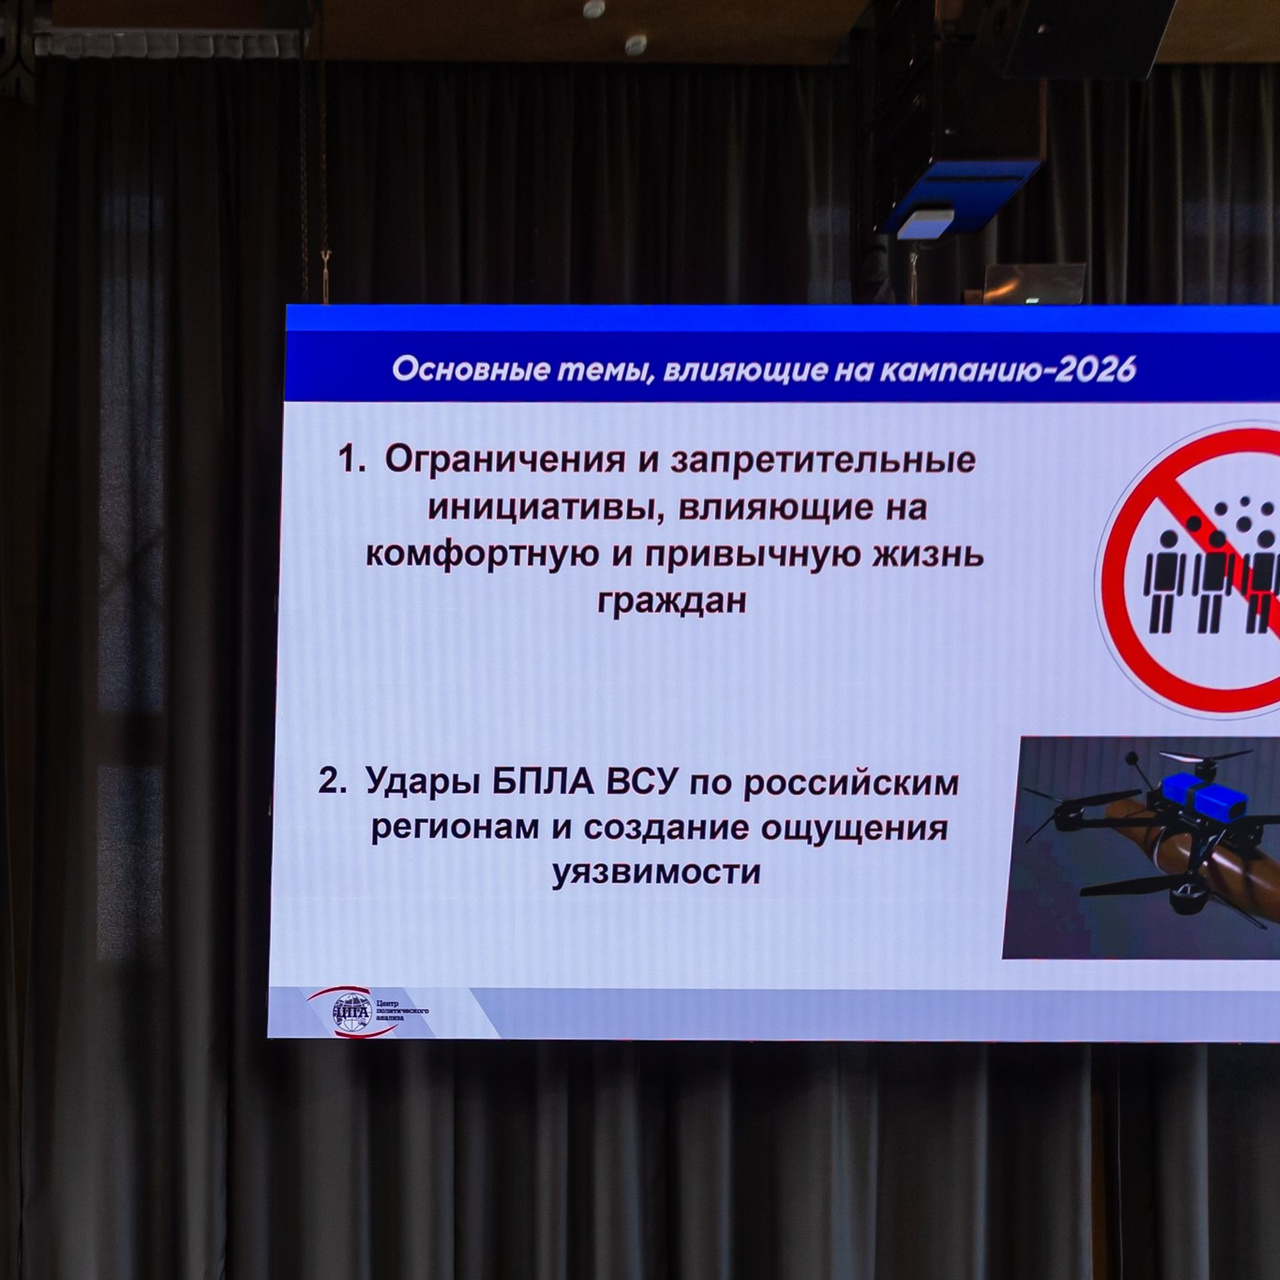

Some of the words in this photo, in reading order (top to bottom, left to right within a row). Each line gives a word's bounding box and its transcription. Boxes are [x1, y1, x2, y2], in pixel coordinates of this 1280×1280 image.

[392, 354, 552, 382] Основные
[557, 361, 655, 386] темы,
[663, 361, 829, 386] влияющие
[834, 362, 875, 382] на
[879, 354, 1137, 383] кампанию-2026
[339, 442, 366, 472] 1.
[385, 442, 626, 480] Ограничения
[638, 450, 659, 473] и
[670, 450, 976, 481] запретительные
[428, 497, 665, 526] инициативы,
[679, 498, 874, 526] влияющие
[886, 498, 927, 521] на
[366, 537, 600, 575] комфортную
[612, 545, 633, 567] и
[645, 544, 862, 575] привычную
[872, 545, 985, 568] жизнь
[598, 591, 747, 621] граждан
[318, 765, 347, 794] 2.
[364, 765, 480, 802] Удары
[493, 766, 595, 795] БПЛА
[607, 766, 680, 796] ВСУ
[690, 774, 733, 796] по
[743, 766, 959, 803] российским
[371, 817, 540, 846] регионам
[552, 818, 572, 840] и
[584, 818, 750, 845] создание
[761, 819, 949, 848] ощущения
[551, 862, 761, 891] уязвимости
[376, 1000, 399, 1008] Центр
[376, 1007, 430, 1015] политического
